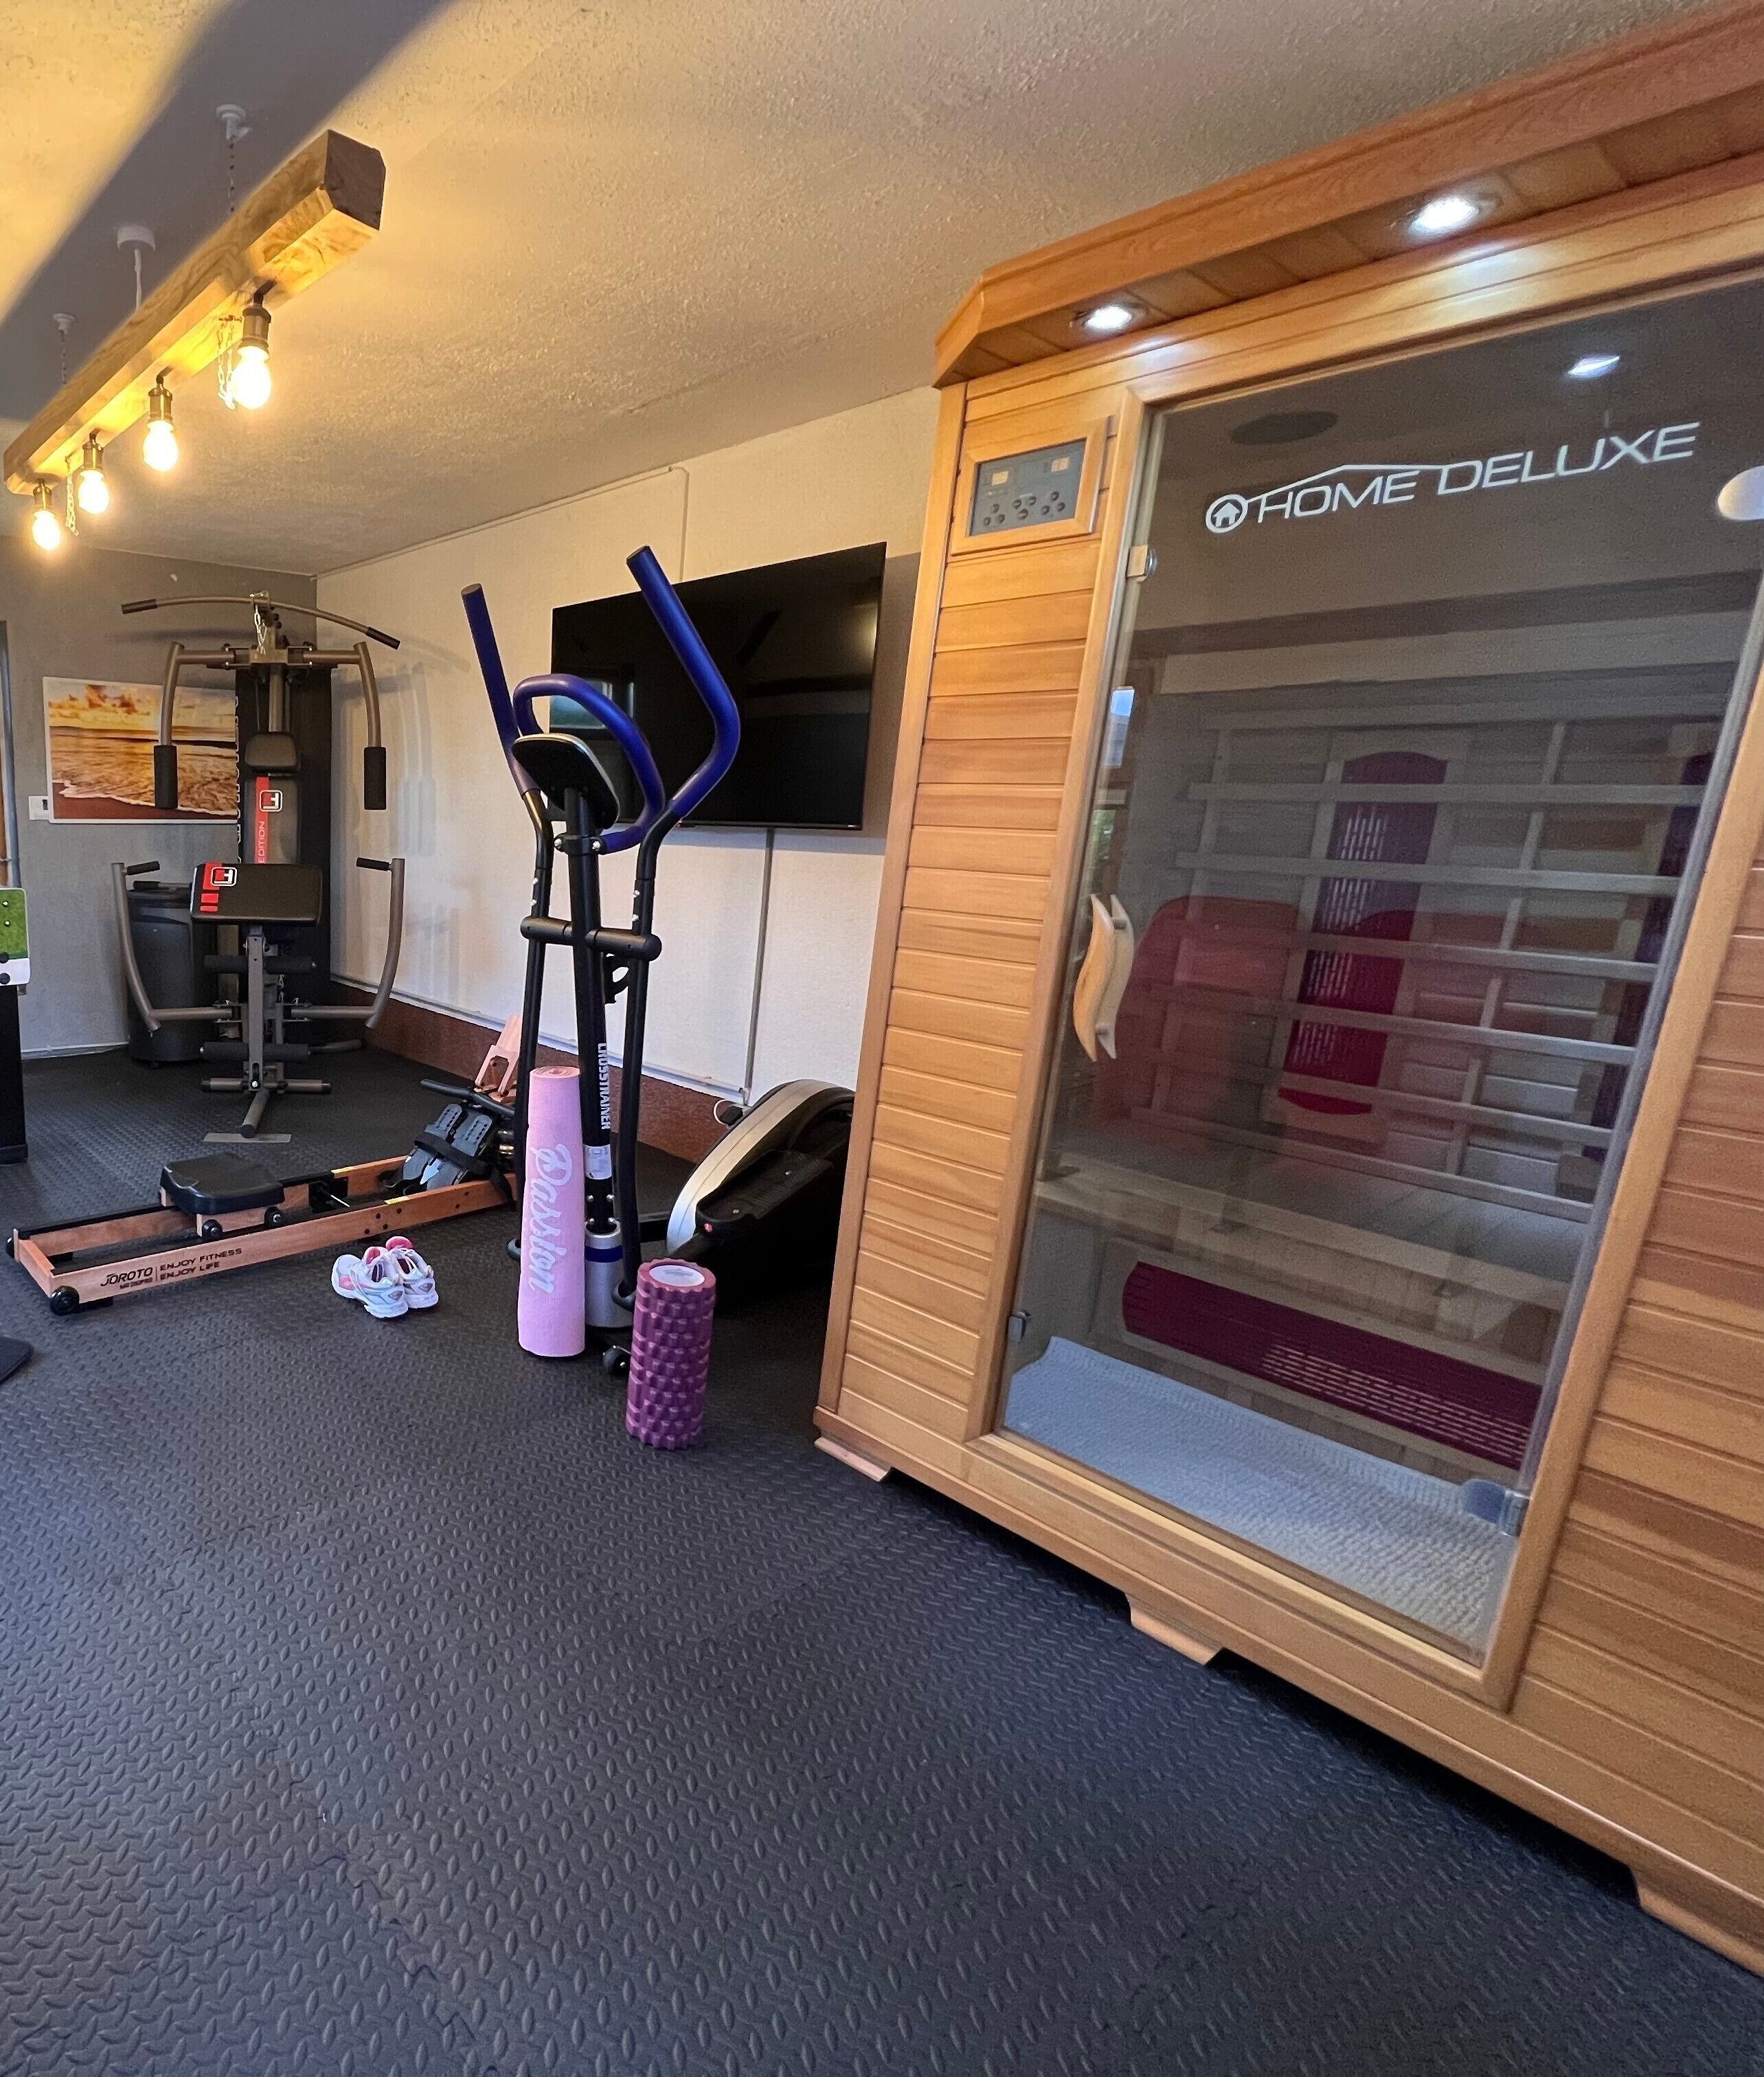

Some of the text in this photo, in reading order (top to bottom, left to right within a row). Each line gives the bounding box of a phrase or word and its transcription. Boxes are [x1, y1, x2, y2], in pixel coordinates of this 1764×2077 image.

[1256, 421, 1701, 523] HOME DELUXE
[160, 1247, 242, 1271] ENJOY FITNESS
[100, 1267, 153, 1286] JOROTO
[160, 1261, 220, 1280] ENJOY LIFE
